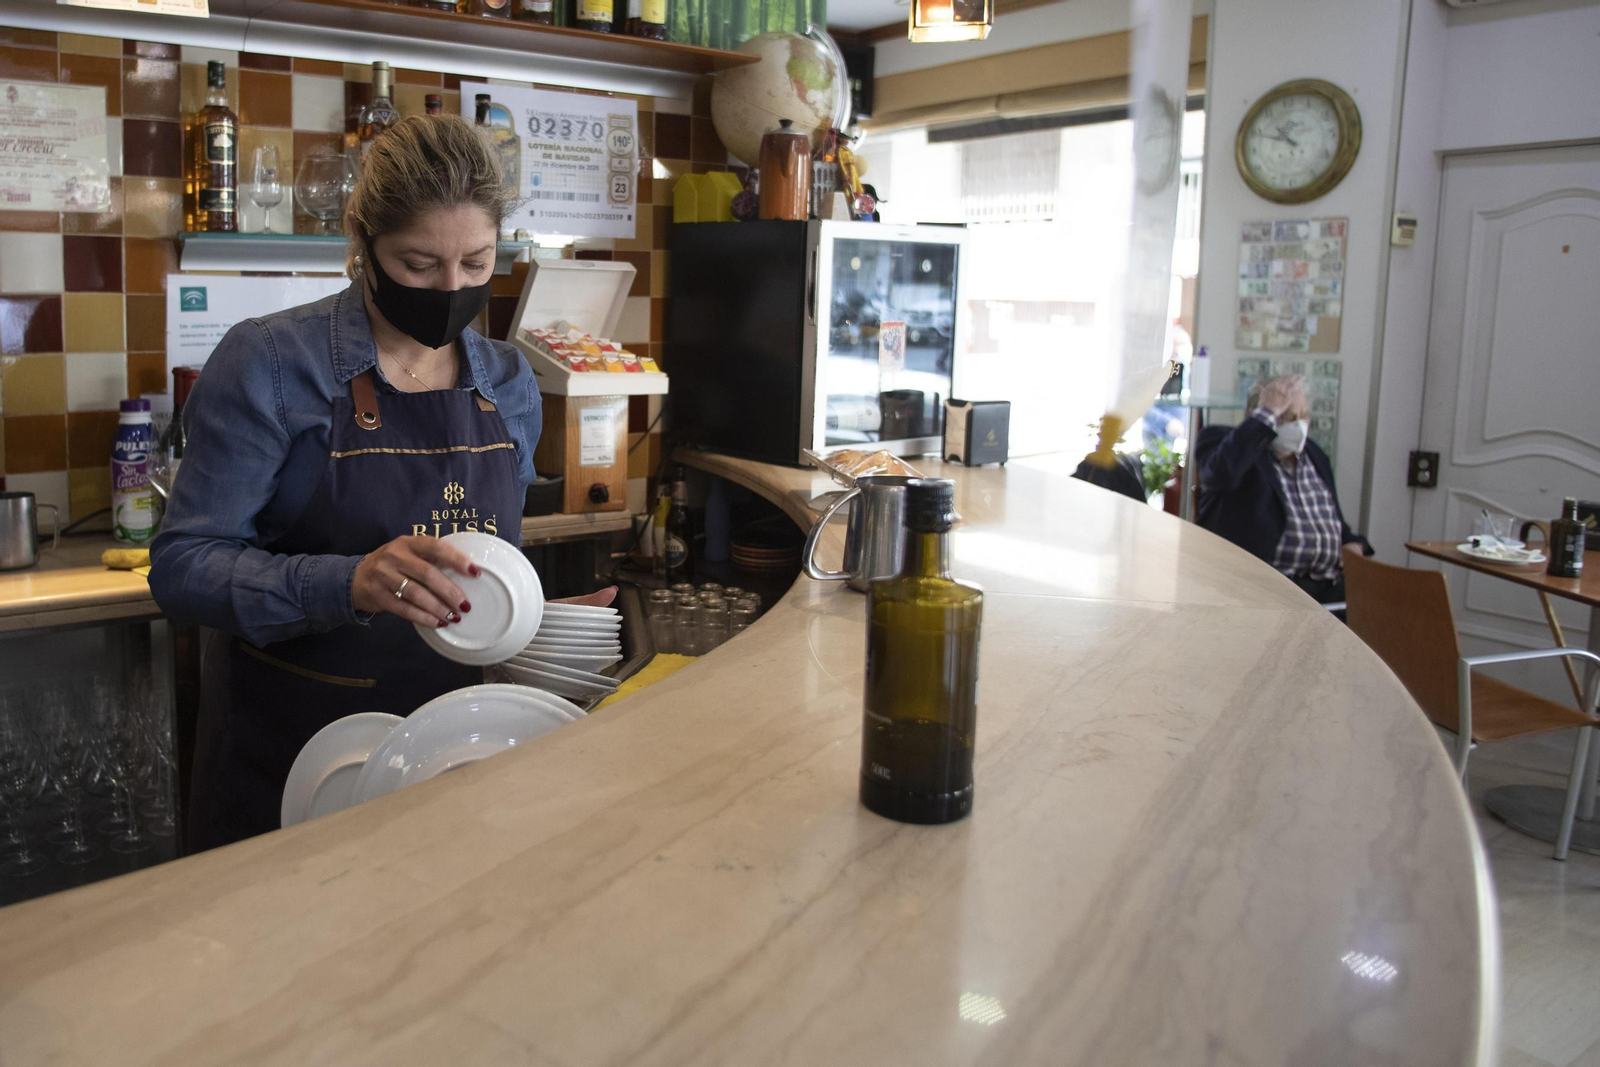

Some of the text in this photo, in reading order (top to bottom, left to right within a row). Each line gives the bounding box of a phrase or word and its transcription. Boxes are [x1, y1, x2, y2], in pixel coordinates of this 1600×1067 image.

[528, 116, 603, 139] 02370
[528, 142, 603, 154] LOTERÍA NACIONAL
[555, 154, 590, 162] NAVIDAD
[550, 162, 577, 170] diciembre
[614, 183, 626, 193] 23
[121, 464, 136, 476] Sin
[431, 508, 478, 520] ROYAL
